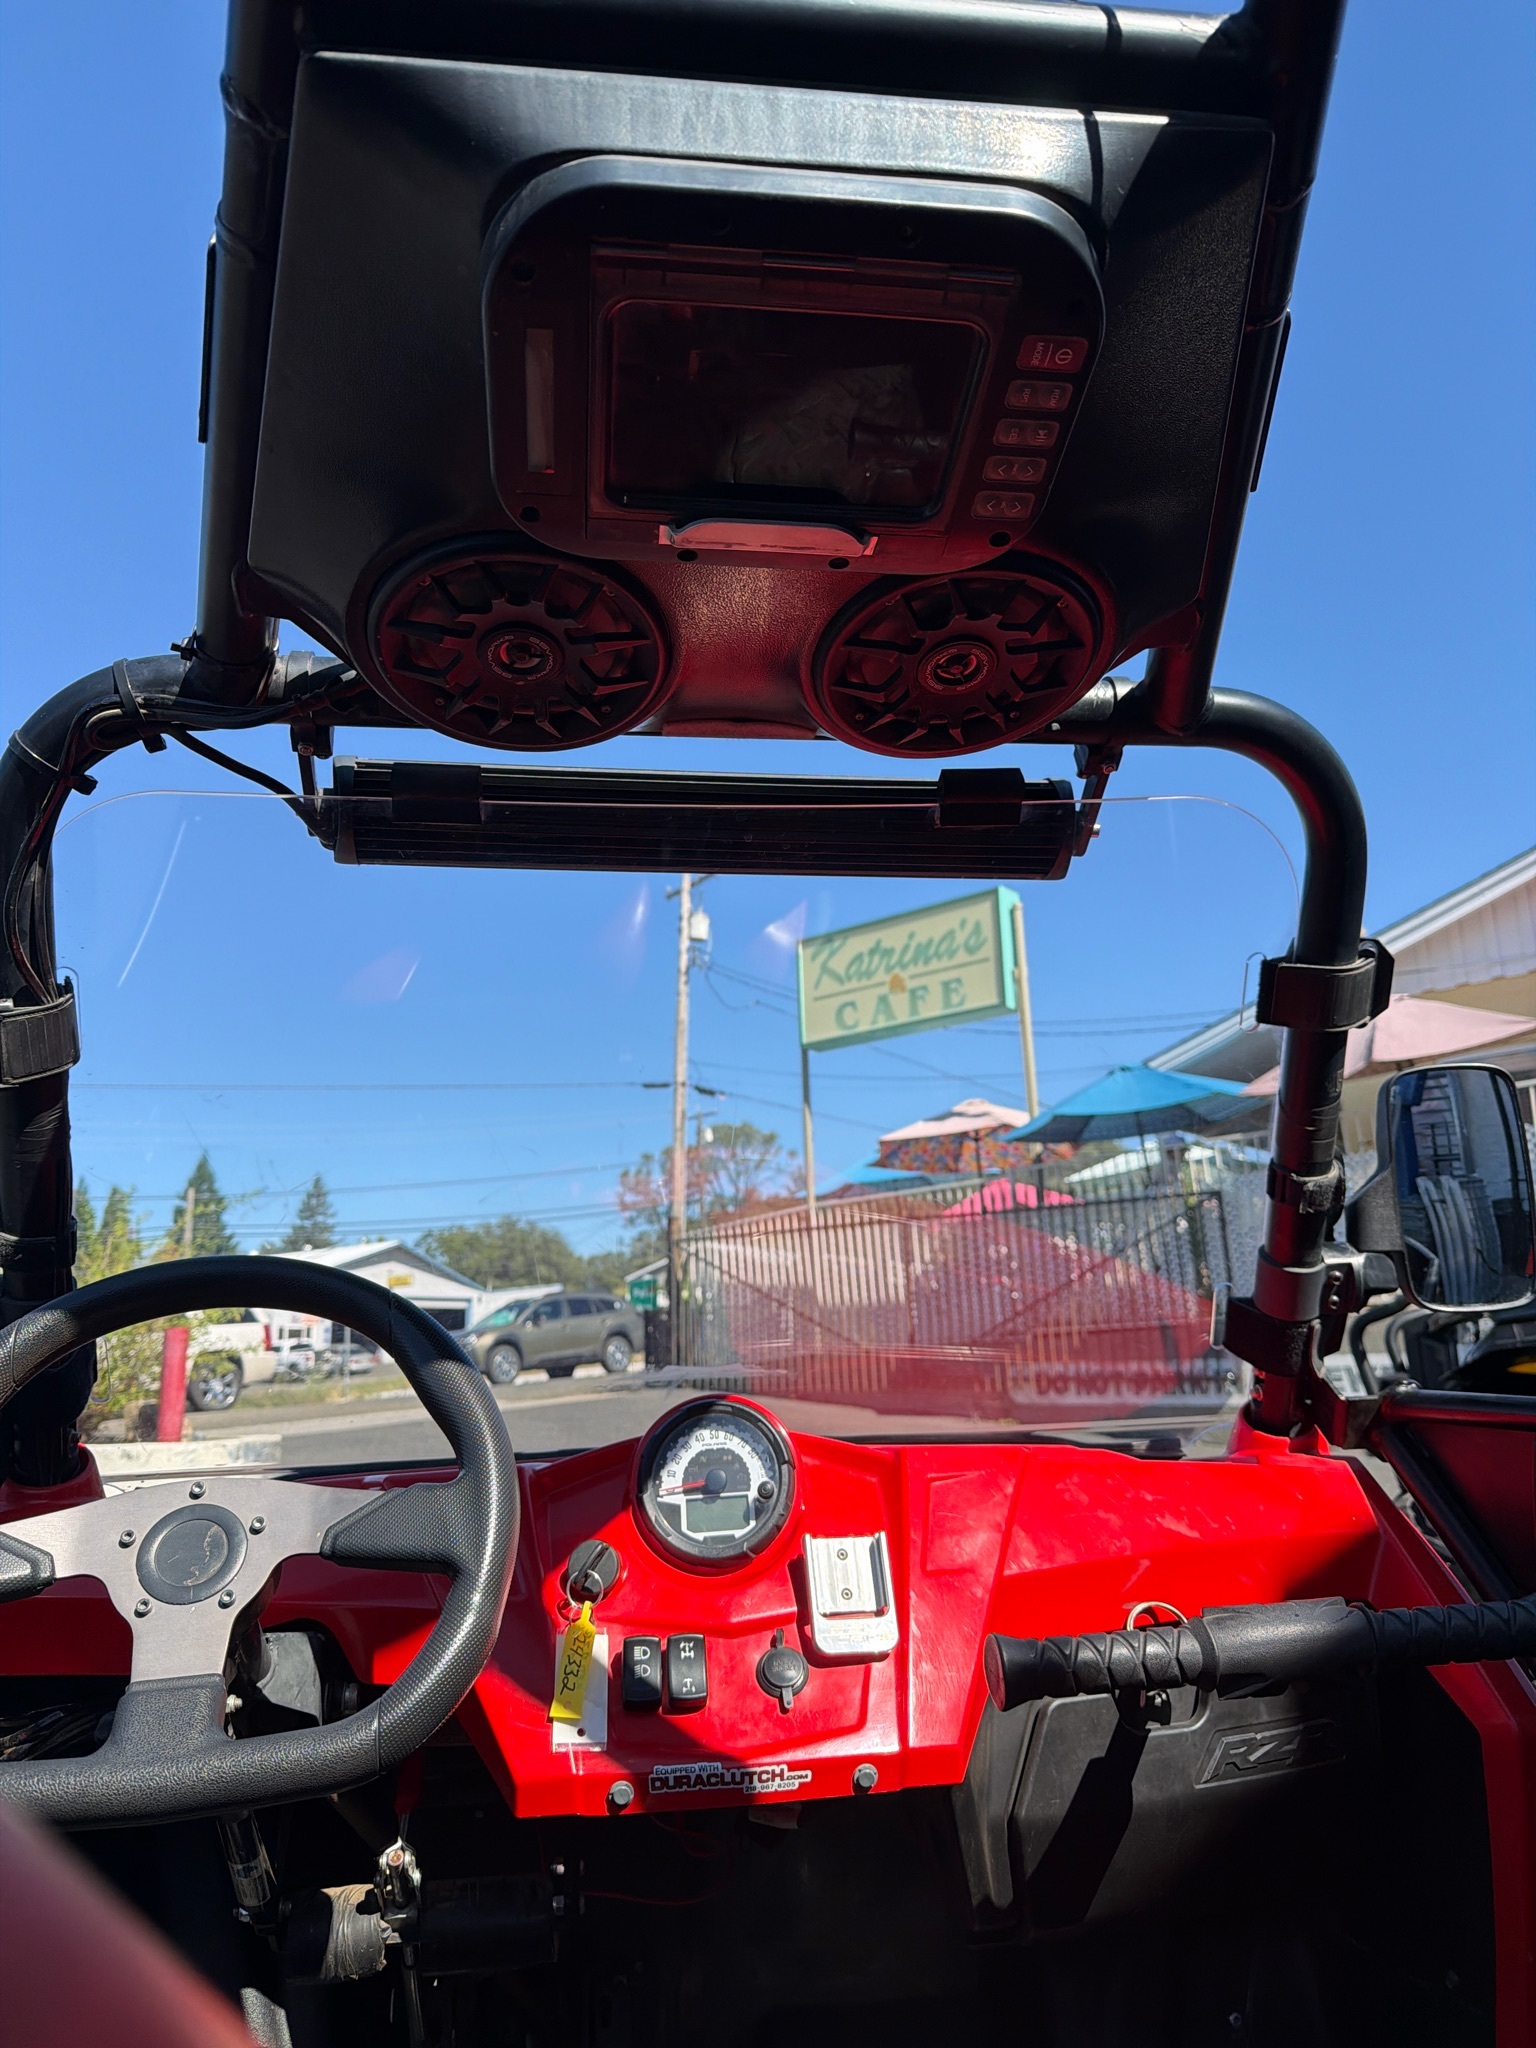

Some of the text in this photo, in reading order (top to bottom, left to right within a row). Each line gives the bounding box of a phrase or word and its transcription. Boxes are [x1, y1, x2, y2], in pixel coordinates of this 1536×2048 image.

[1031, 342, 1045, 366] MODE
[810, 916, 989, 991] Katrina's
[834, 976, 968, 1032] CAFE
[695, 1432, 706, 1443] 40
[709, 1429, 720, 1440] 50
[723, 1431, 735, 1441] 60
[683, 1442, 692, 1453] 30
[737, 1439, 747, 1449] 70
[672, 1453, 683, 1465] 20
[667, 1469, 677, 1478] 10
[655, 1765, 697, 1776] EQUIPPED
